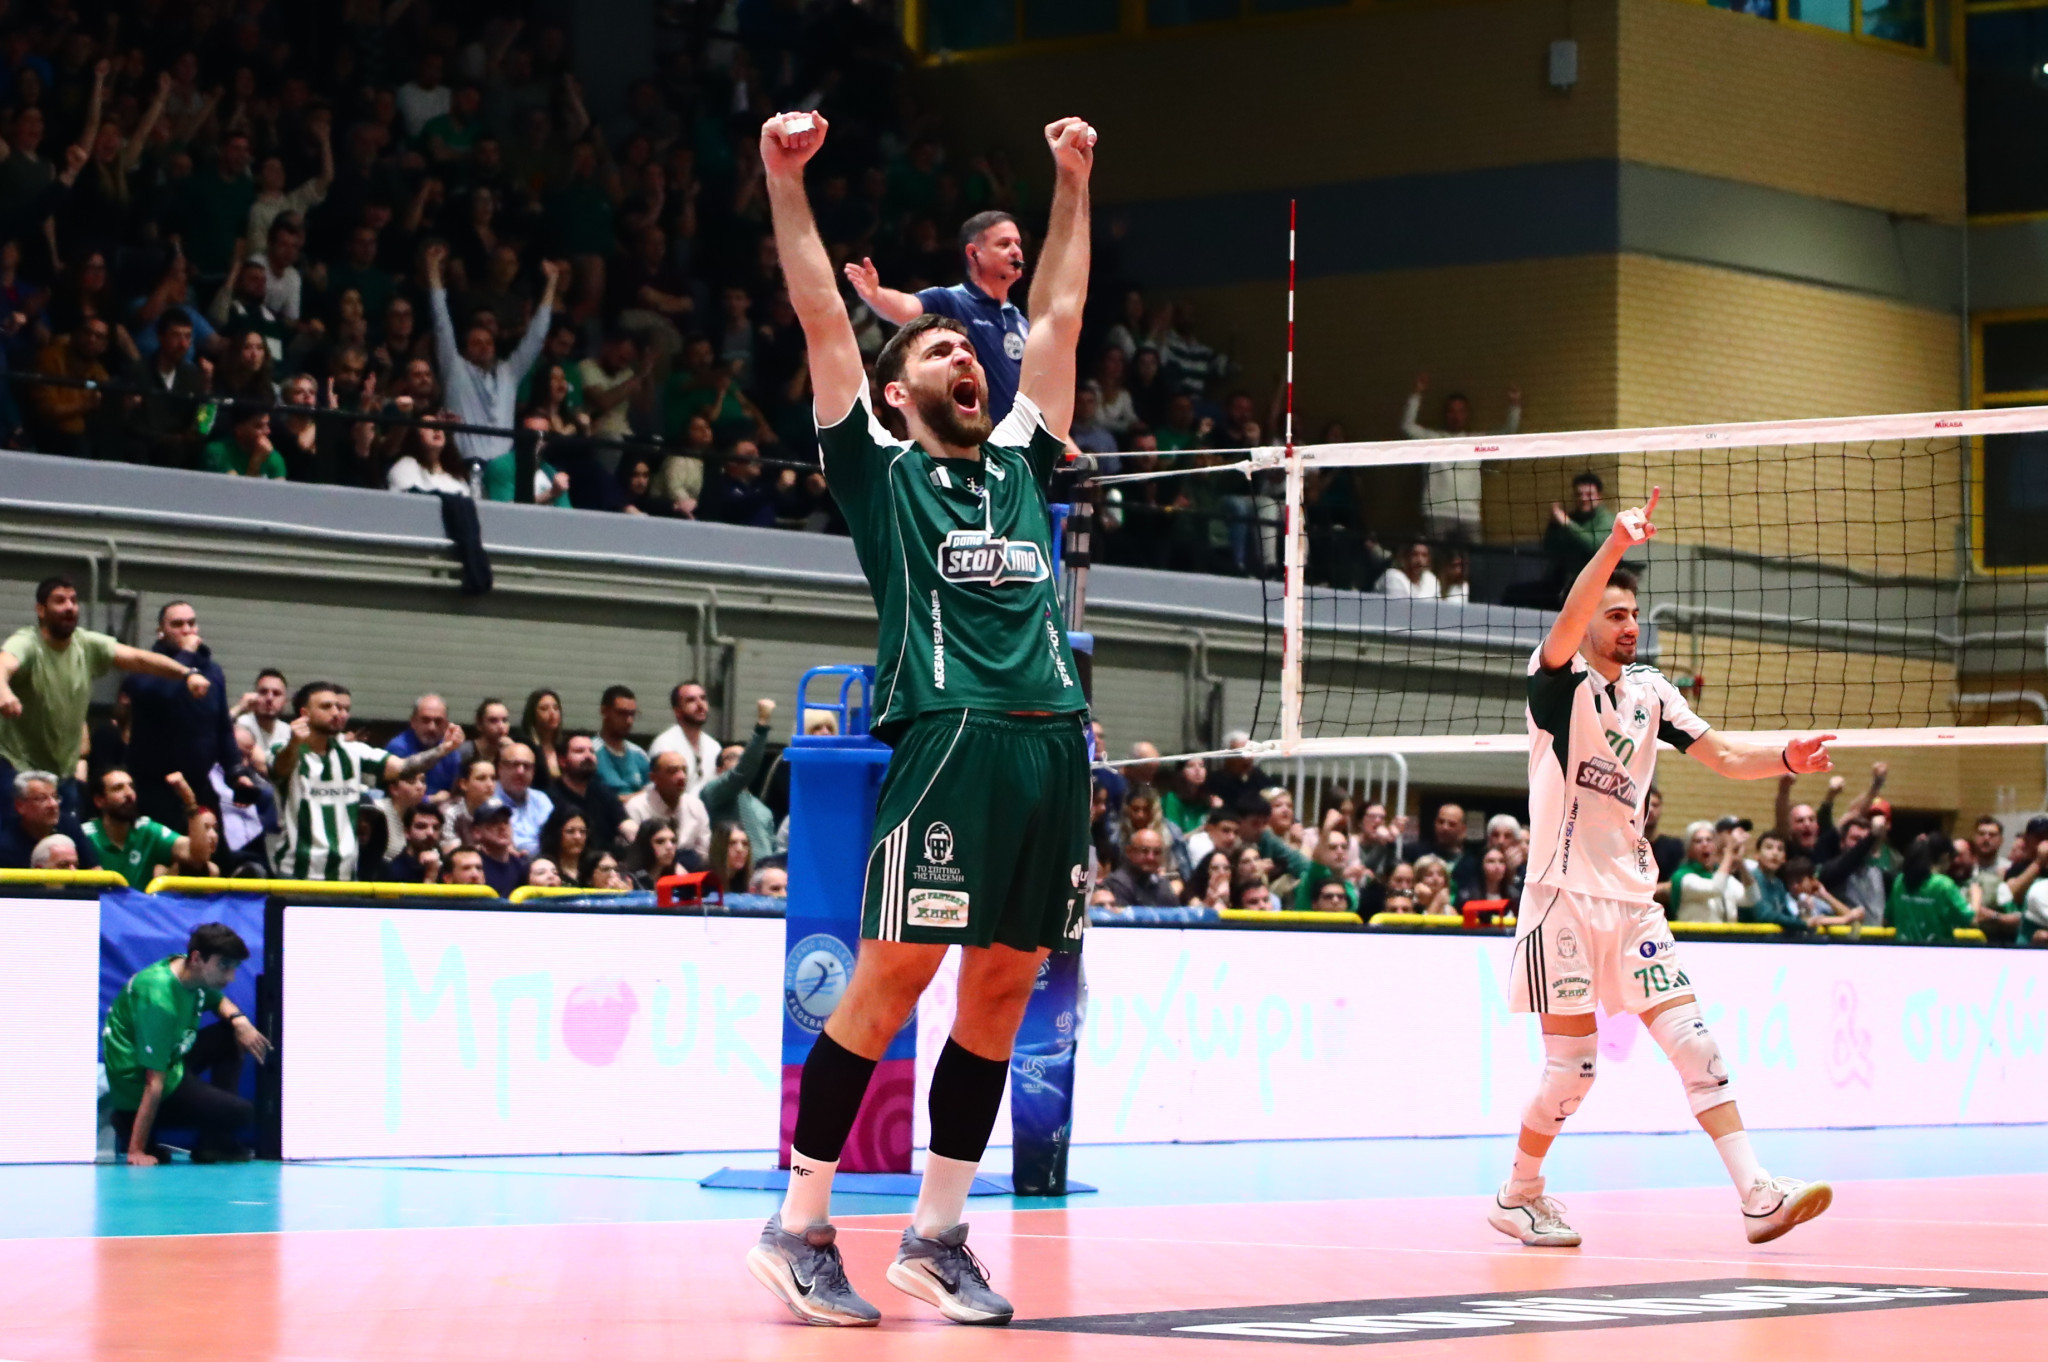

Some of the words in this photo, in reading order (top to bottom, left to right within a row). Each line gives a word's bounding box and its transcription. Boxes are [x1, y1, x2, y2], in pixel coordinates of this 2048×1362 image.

[934, 645, 945, 690] AEGEAN
[1565, 821, 1575, 838] SEA
[1562, 839, 1571, 875] AEGEAN
[1633, 964, 1670, 998] 70
[788, 998, 823, 1029] FEDERA
